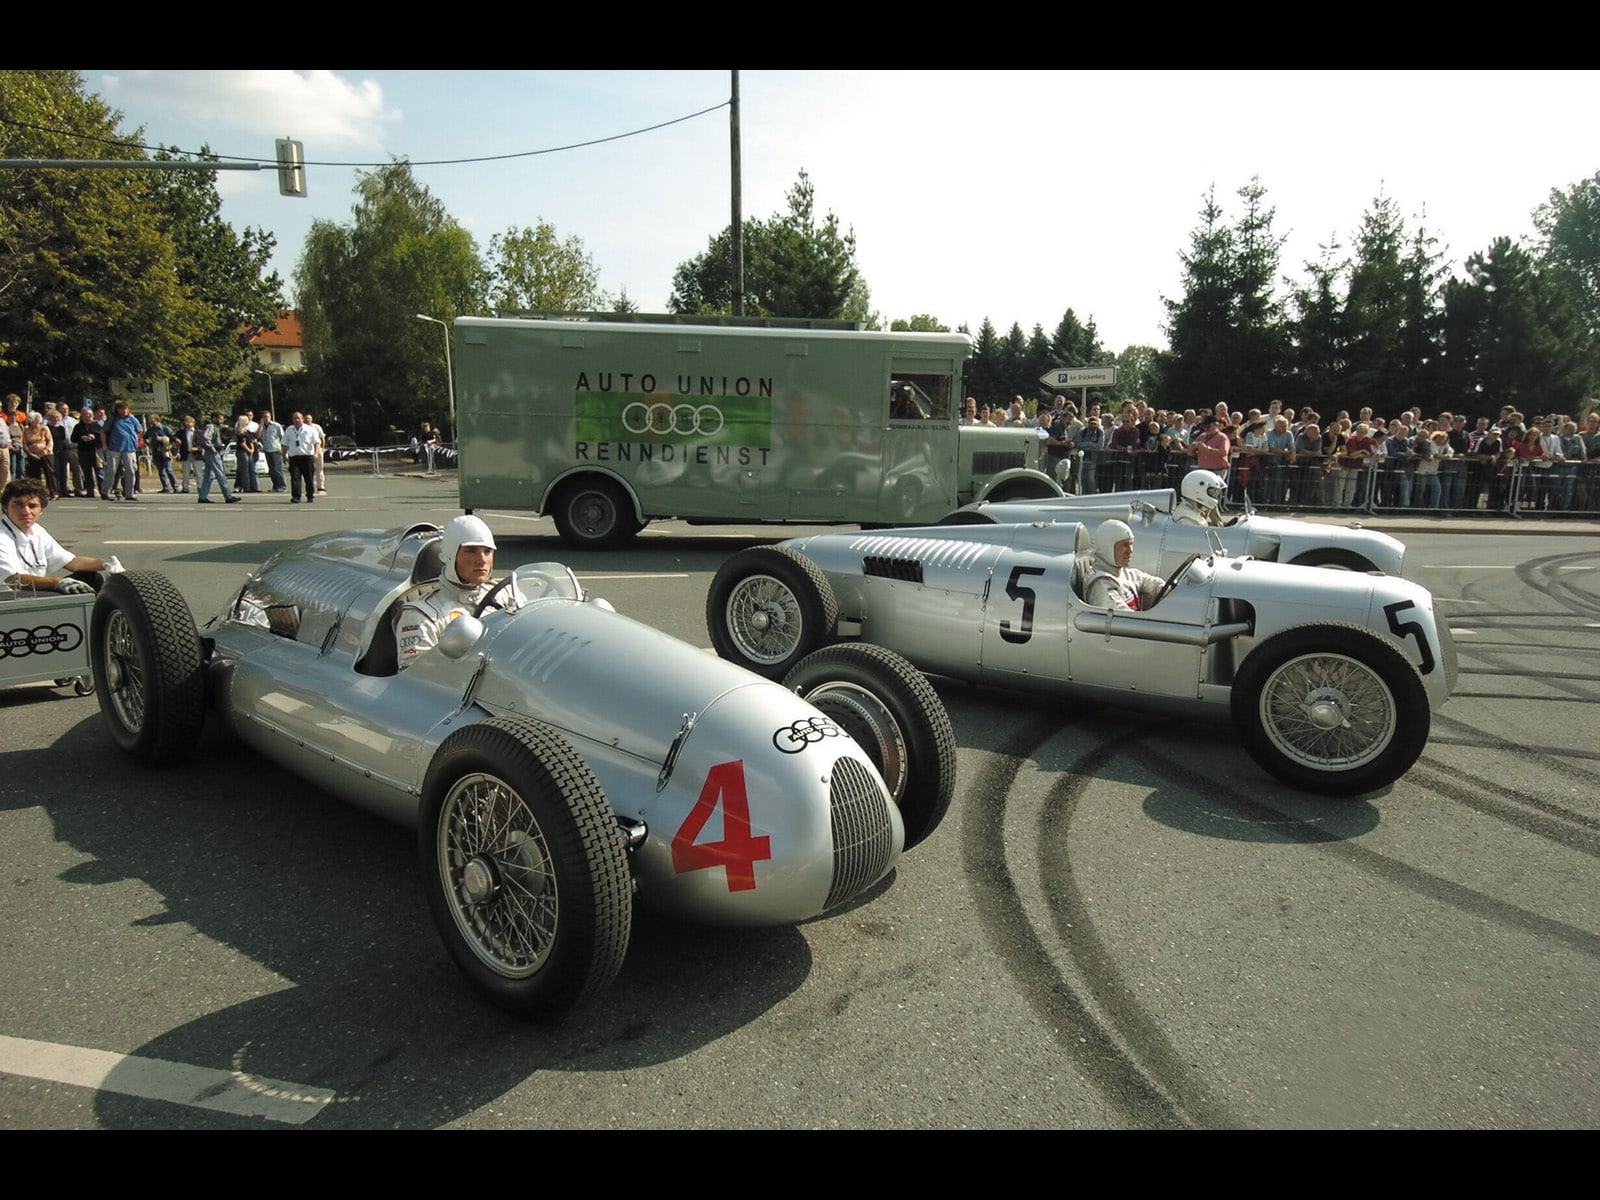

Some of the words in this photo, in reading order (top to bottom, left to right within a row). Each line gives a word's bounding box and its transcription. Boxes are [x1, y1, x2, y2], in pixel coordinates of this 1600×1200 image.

[575, 371, 657, 393] AUTO
[677, 375, 773, 397] UNION
[575, 441, 772, 466] RENNDIENST
[1000, 565, 1046, 645] 5
[0, 640, 26, 648] AUTO
[31, 635, 64, 644] UNION
[1382, 599, 1436, 676] 5
[792, 726, 814, 740] AUTO
[671, 759, 771, 893] 4
